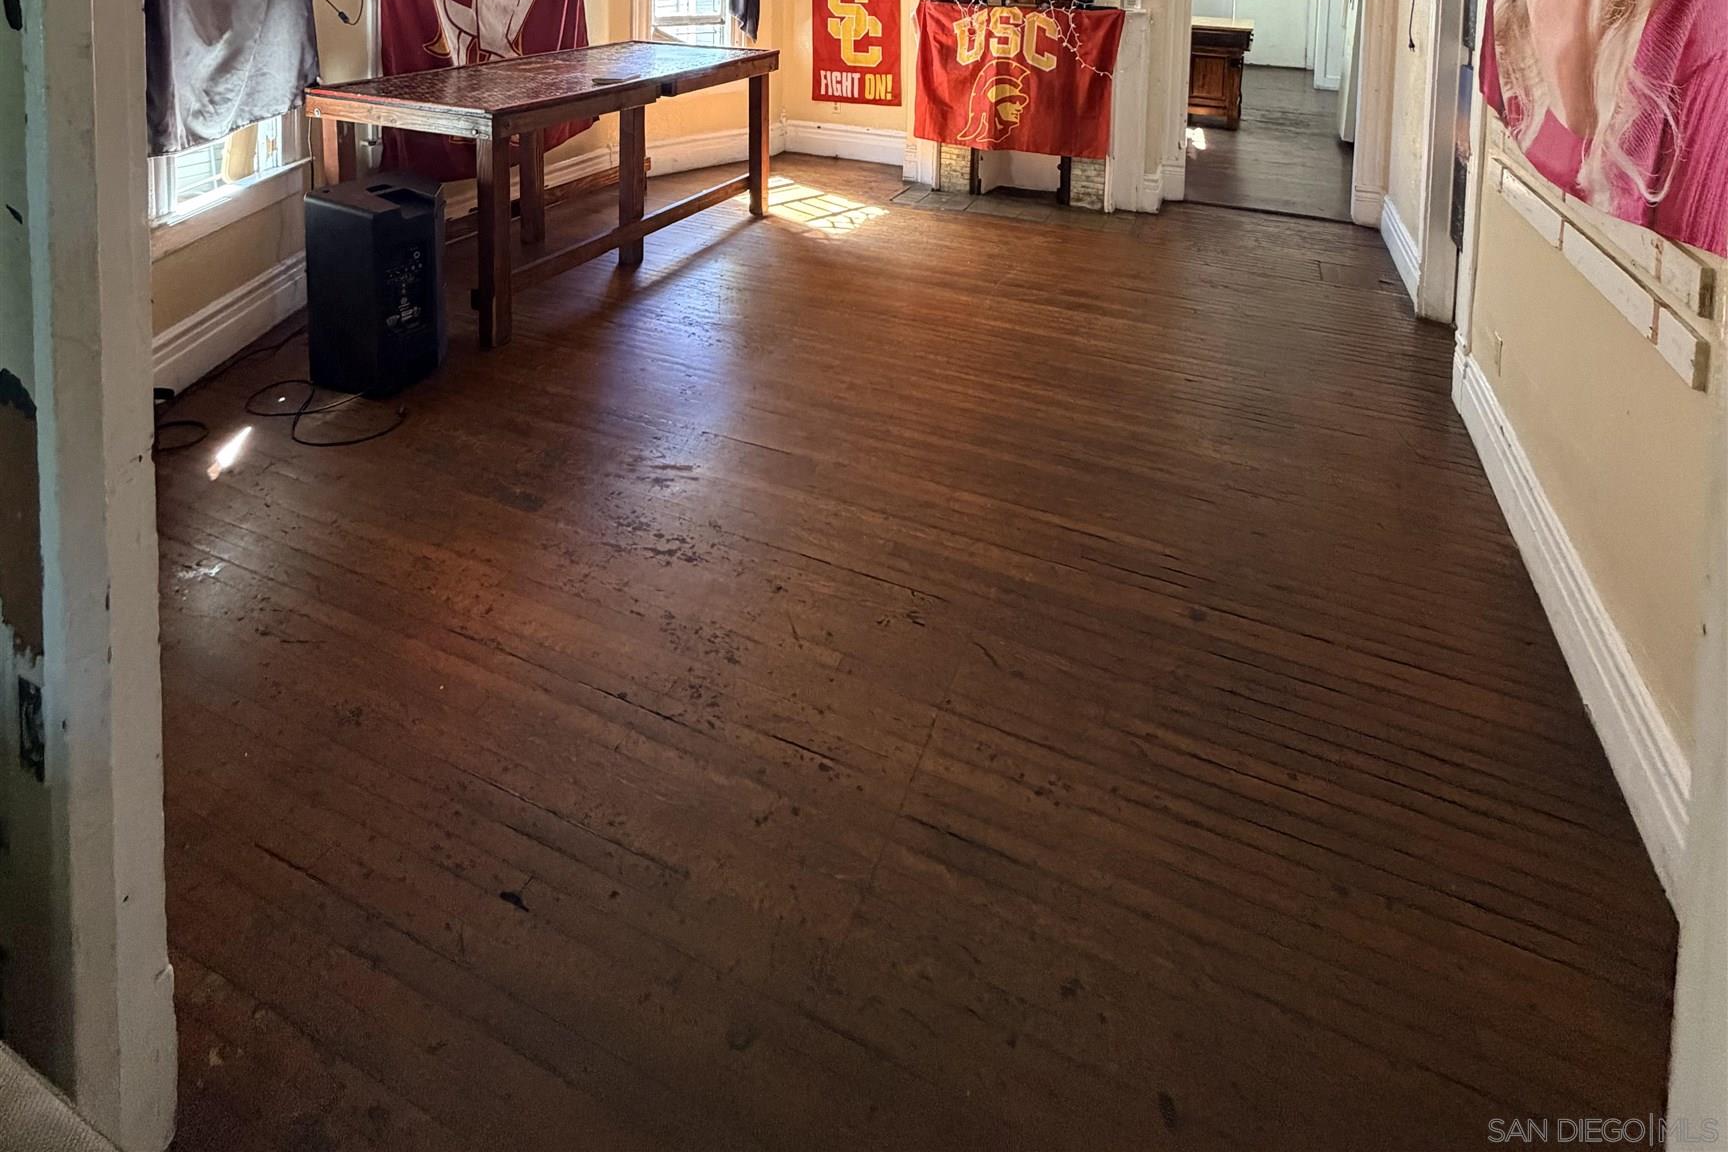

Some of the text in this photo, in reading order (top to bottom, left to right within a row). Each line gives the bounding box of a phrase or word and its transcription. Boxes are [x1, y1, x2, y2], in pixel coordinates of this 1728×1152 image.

[953, 6, 1060, 72] USC
[820, 70, 893, 101] FIGHT ON!
